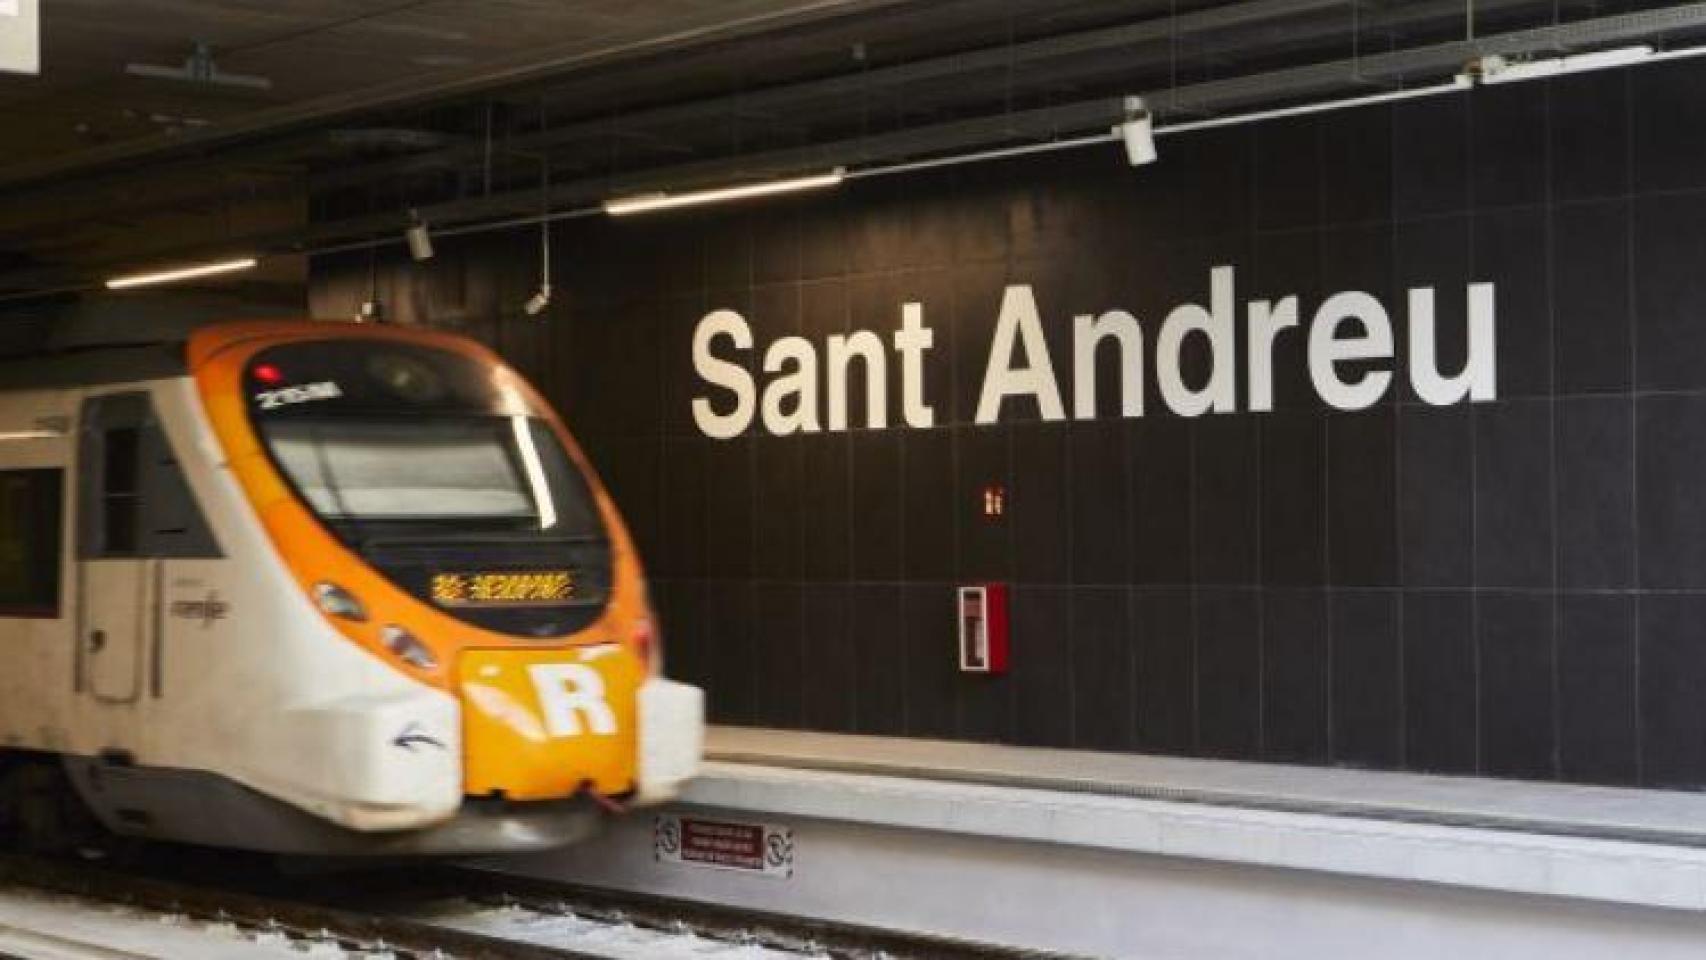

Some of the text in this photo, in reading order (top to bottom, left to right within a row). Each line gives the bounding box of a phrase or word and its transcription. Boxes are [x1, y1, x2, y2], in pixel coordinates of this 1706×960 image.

[692, 265, 1498, 440] Sant Andreu
[528, 661, 617, 738] R
